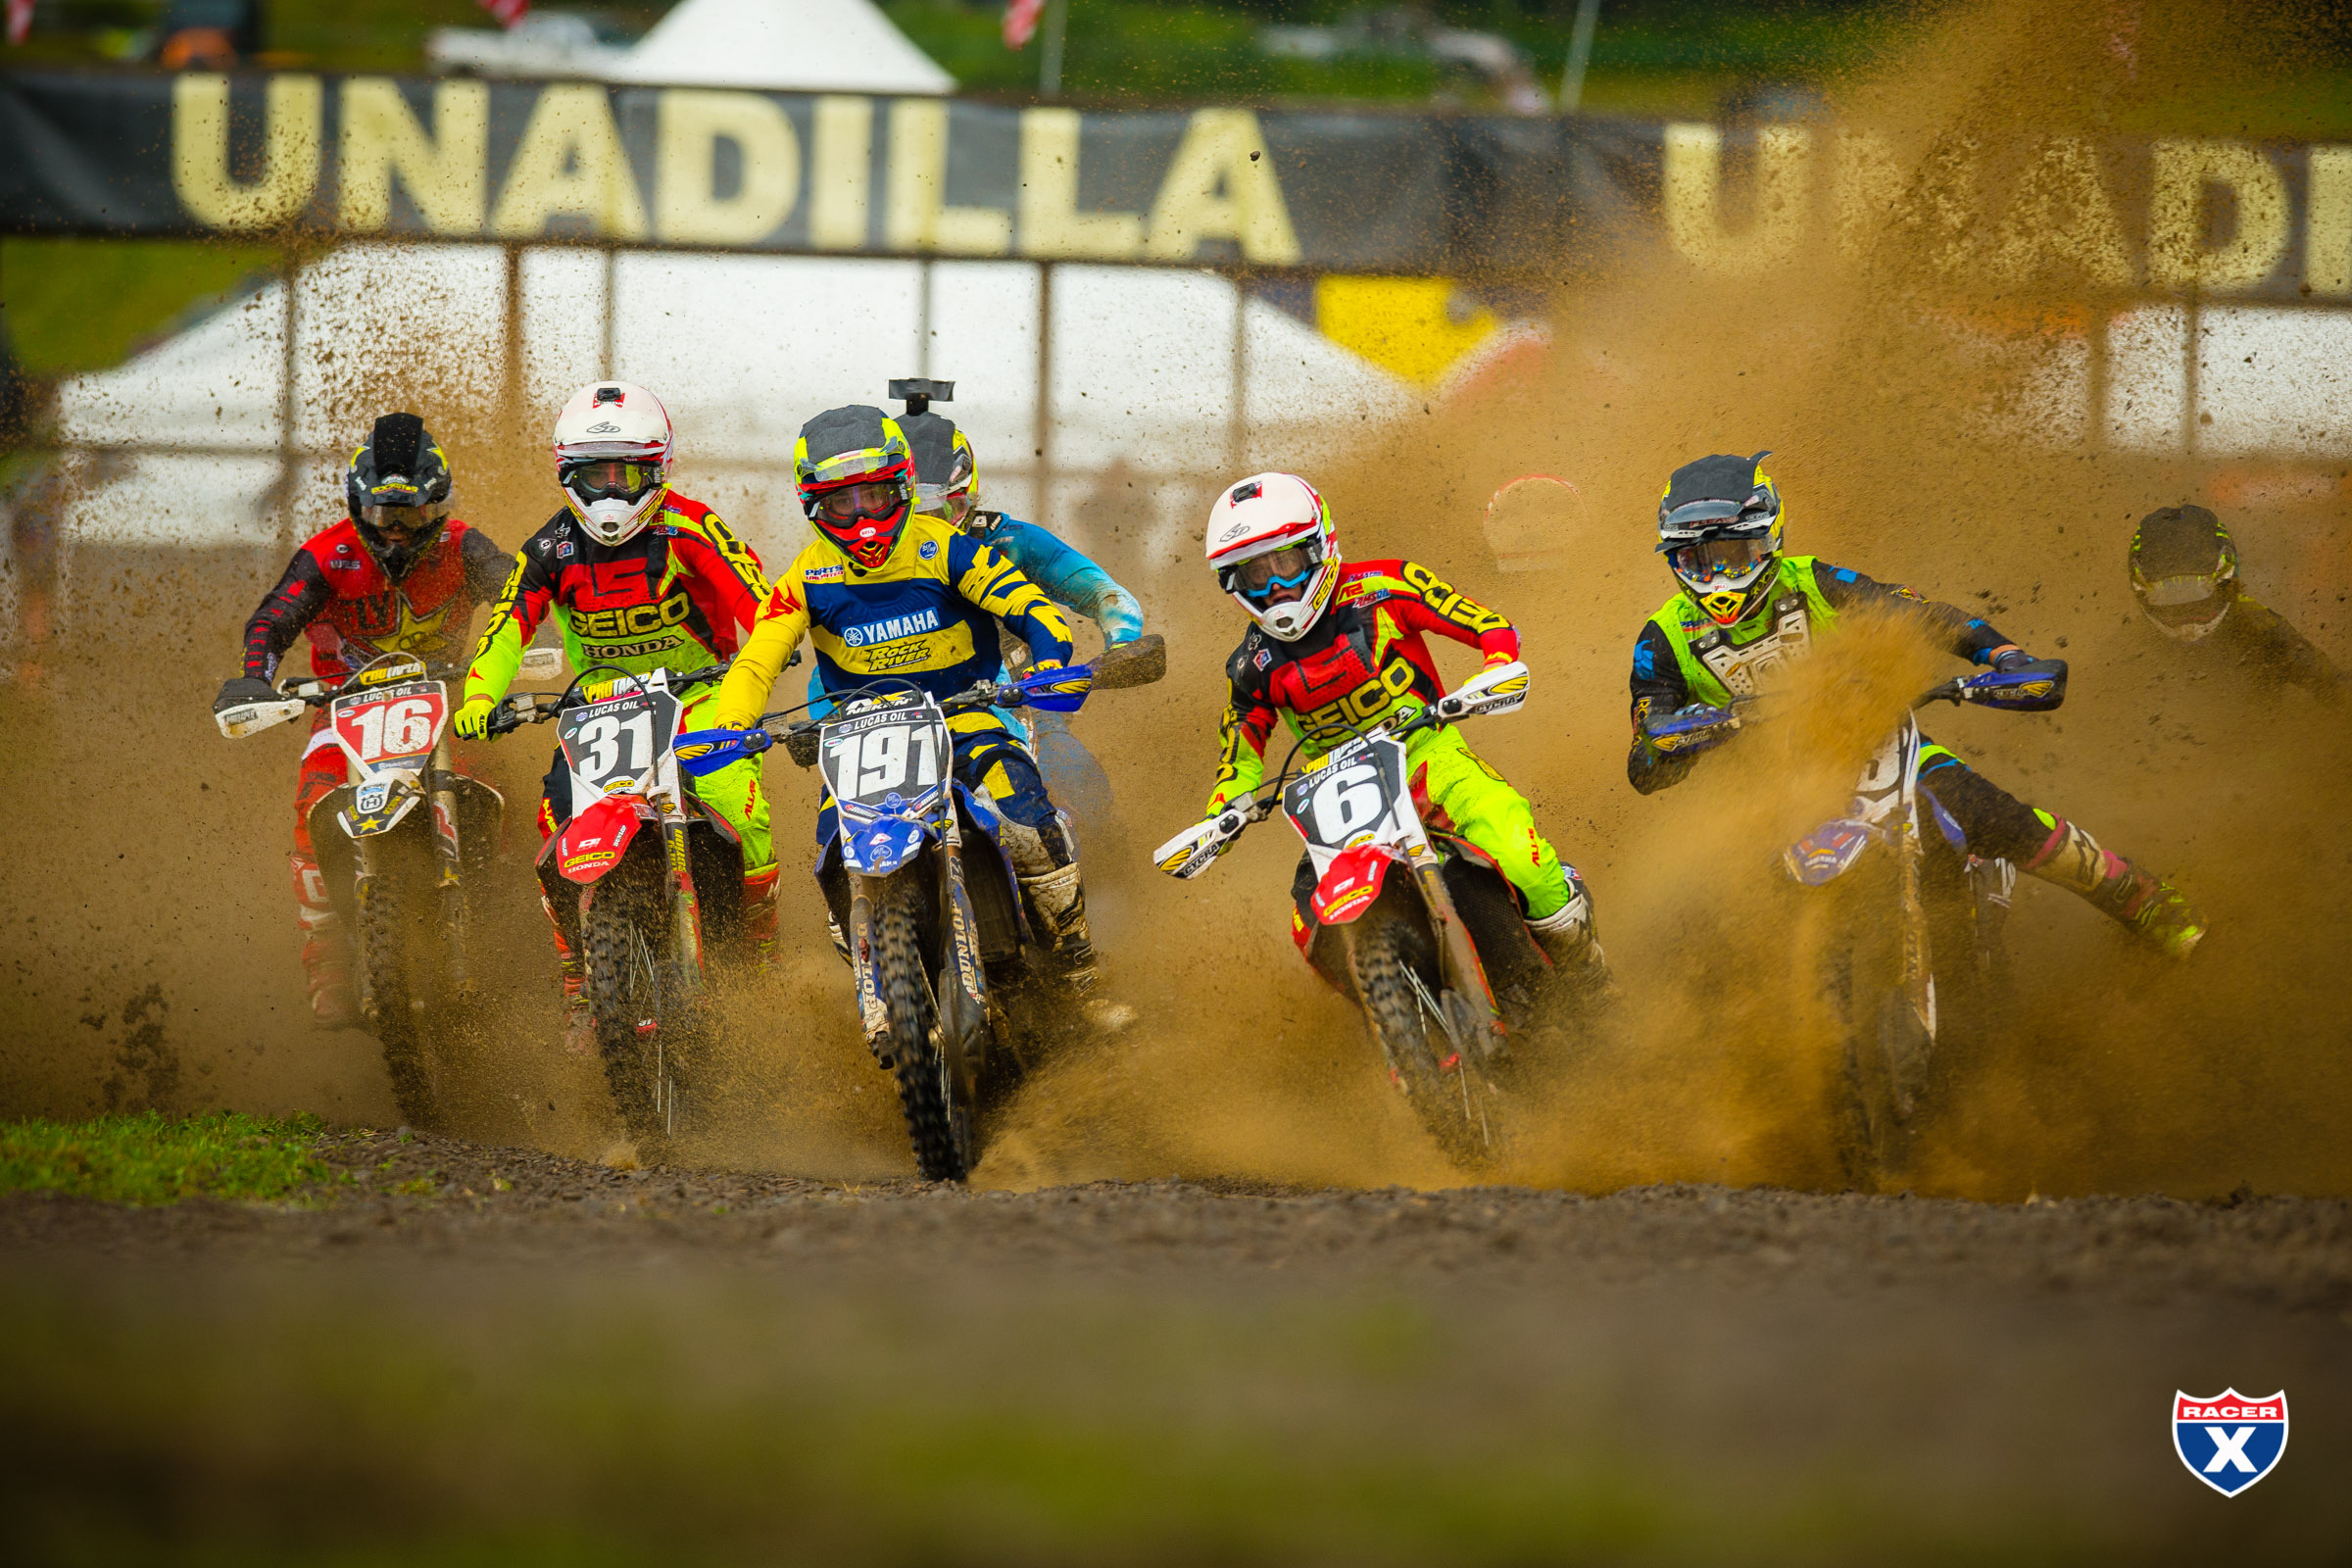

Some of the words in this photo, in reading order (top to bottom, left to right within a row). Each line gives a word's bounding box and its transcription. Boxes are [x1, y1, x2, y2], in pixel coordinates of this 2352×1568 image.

[171, 74, 1301, 265] UNADILLA
[805, 564, 844, 576] PARTS
[1313, 555, 1339, 611] GEICO
[1355, 589, 1392, 607] AMSOIL
[568, 591, 690, 637] GEICO
[862, 610, 939, 643] YAMAHA
[582, 635, 684, 659] HONDA
[867, 648, 930, 672] RIVER
[868, 640, 927, 661] ROCK
[364, 691, 395, 703] LUCS
[397, 687, 412, 697] OIL
[588, 703, 620, 718] LUCAS
[622, 700, 639, 710] OIL
[1295, 657, 1415, 740] GEICO
[1476, 697, 1516, 712] CYCRA
[351, 699, 433, 760] 16
[855, 712, 888, 730] LUCAS
[890, 711, 907, 721] OIL
[577, 710, 653, 783] 31
[829, 724, 944, 801] 191
[1308, 764, 1339, 788] LUCAS
[1340, 757, 1357, 770] OIL
[604, 780, 635, 793] GEICO
[1312, 764, 1383, 844] 6
[564, 851, 616, 869] GEICO
[567, 860, 611, 874] HONDA
[1184, 843, 1220, 875] CYCRA
[1324, 884, 1374, 917] GEICO
[1329, 895, 1371, 921] HONDA
[951, 900, 978, 994] DUNLOP
